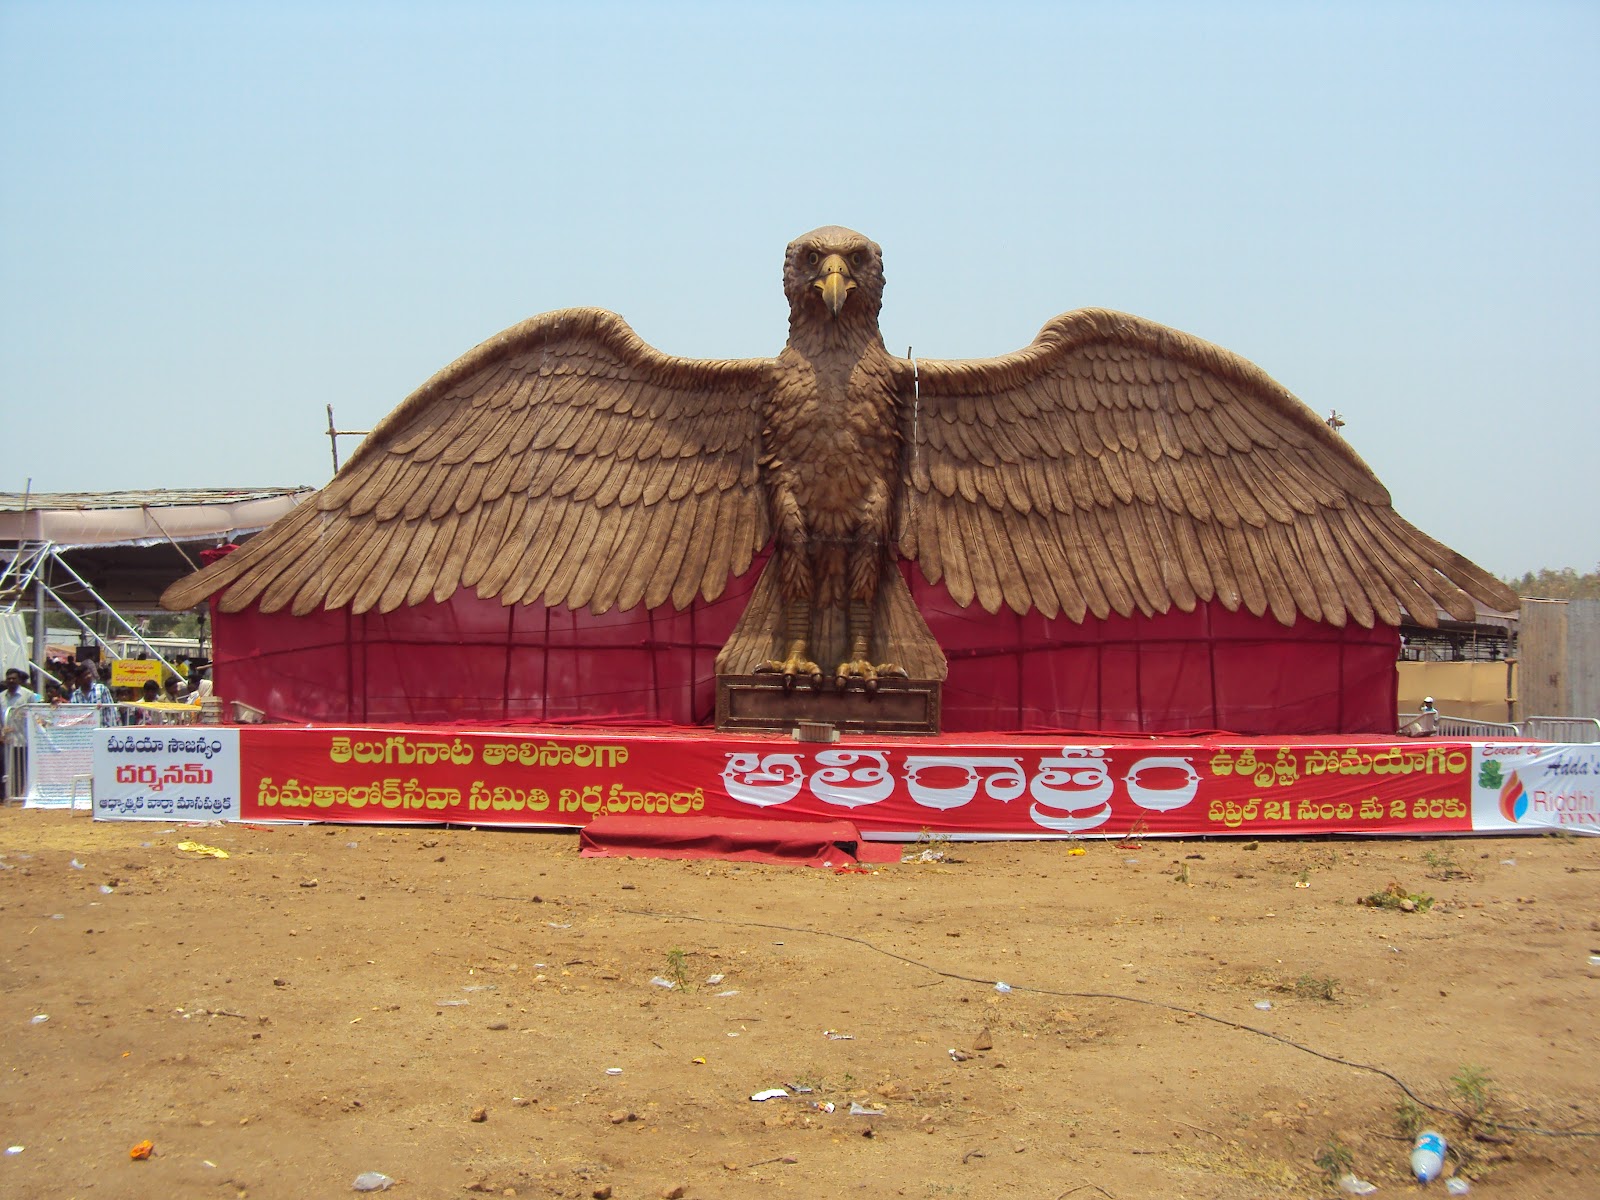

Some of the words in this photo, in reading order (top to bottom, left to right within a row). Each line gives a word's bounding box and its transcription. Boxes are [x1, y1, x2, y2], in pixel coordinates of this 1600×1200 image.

[107, 735, 164, 753] మీడియా
[167, 737, 222, 760] సౌజన్యం
[330, 736, 474, 765] తెలుగునాట
[482, 741, 629, 768] తొలిసారిగా
[1304, 747, 1467, 776] సోమయాగం
[1482, 742, 1523, 757] Event
[116, 763, 213, 792] దర్శనమ్
[717, 747, 1203, 834] అతిరాత్రం
[99, 796, 144, 814] ఆధ్యాత్మిక
[176, 796, 232, 814] మాసపత్రిక
[468, 780, 550, 812] సమితి
[558, 783, 705, 821] నిర్వహణలో
[1208, 798, 1262, 828] ఏప్రిల్
[1264, 801, 1292, 820] 21
[1297, 799, 1354, 820] నుంచి
[1359, 796, 1384, 820] మే
[1389, 799, 1407, 819] 2
[1412, 798, 1467, 819] వరకు
[1533, 790, 1595, 812] Riddhi
[1559, 813, 1600, 825] EVEN
